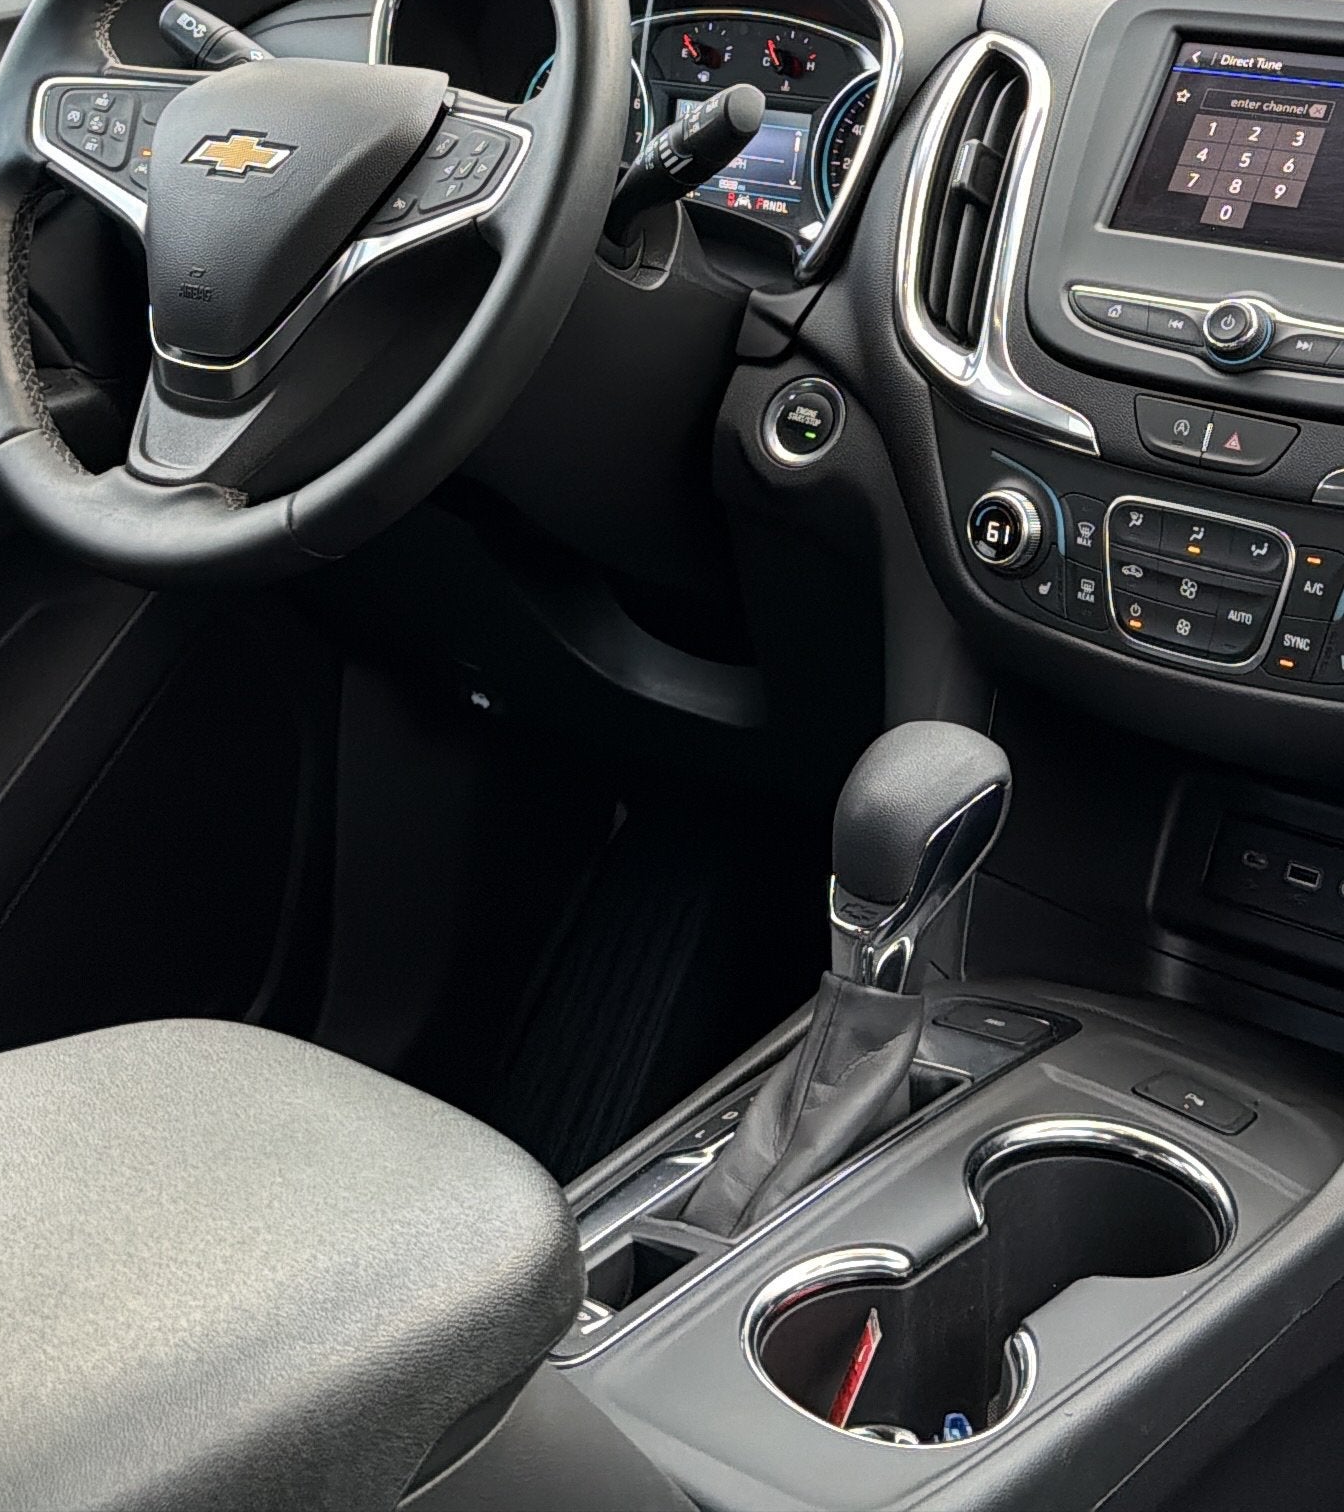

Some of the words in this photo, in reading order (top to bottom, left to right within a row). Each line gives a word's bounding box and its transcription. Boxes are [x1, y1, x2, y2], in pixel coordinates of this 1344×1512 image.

[681, 47, 688, 58] E
[724, 52, 733, 63] F
[762, 56, 771, 67] C
[806, 61, 816, 72] H
[1220, 54, 1254, 68] Direct
[1256, 57, 1283, 71] Tune
[633, 98, 641, 110] 6
[1230, 98, 1262, 110] enter
[1263, 100, 1309, 116] channel
[1208, 122, 1217, 136] 1
[1248, 127, 1261, 141] 2
[635, 131, 643, 144] 7
[1292, 131, 1304, 147] 3
[1196, 148, 1209, 162] 4
[1239, 153, 1252, 168] 5
[1283, 158, 1295, 173] 6
[1187, 173, 1200, 187] 7
[1229, 179, 1243, 194] 8
[1274, 184, 1287, 199] 9
[1219, 204, 1233, 220] 0
[986, 522, 1011, 545] 61
[1076, 537, 1092, 547] MAX
[1303, 580, 1324, 596] A/C
[1077, 592, 1095, 603] REAR
[1228, 609, 1252, 625] AUTO
[1283, 633, 1310, 651] SYNC
